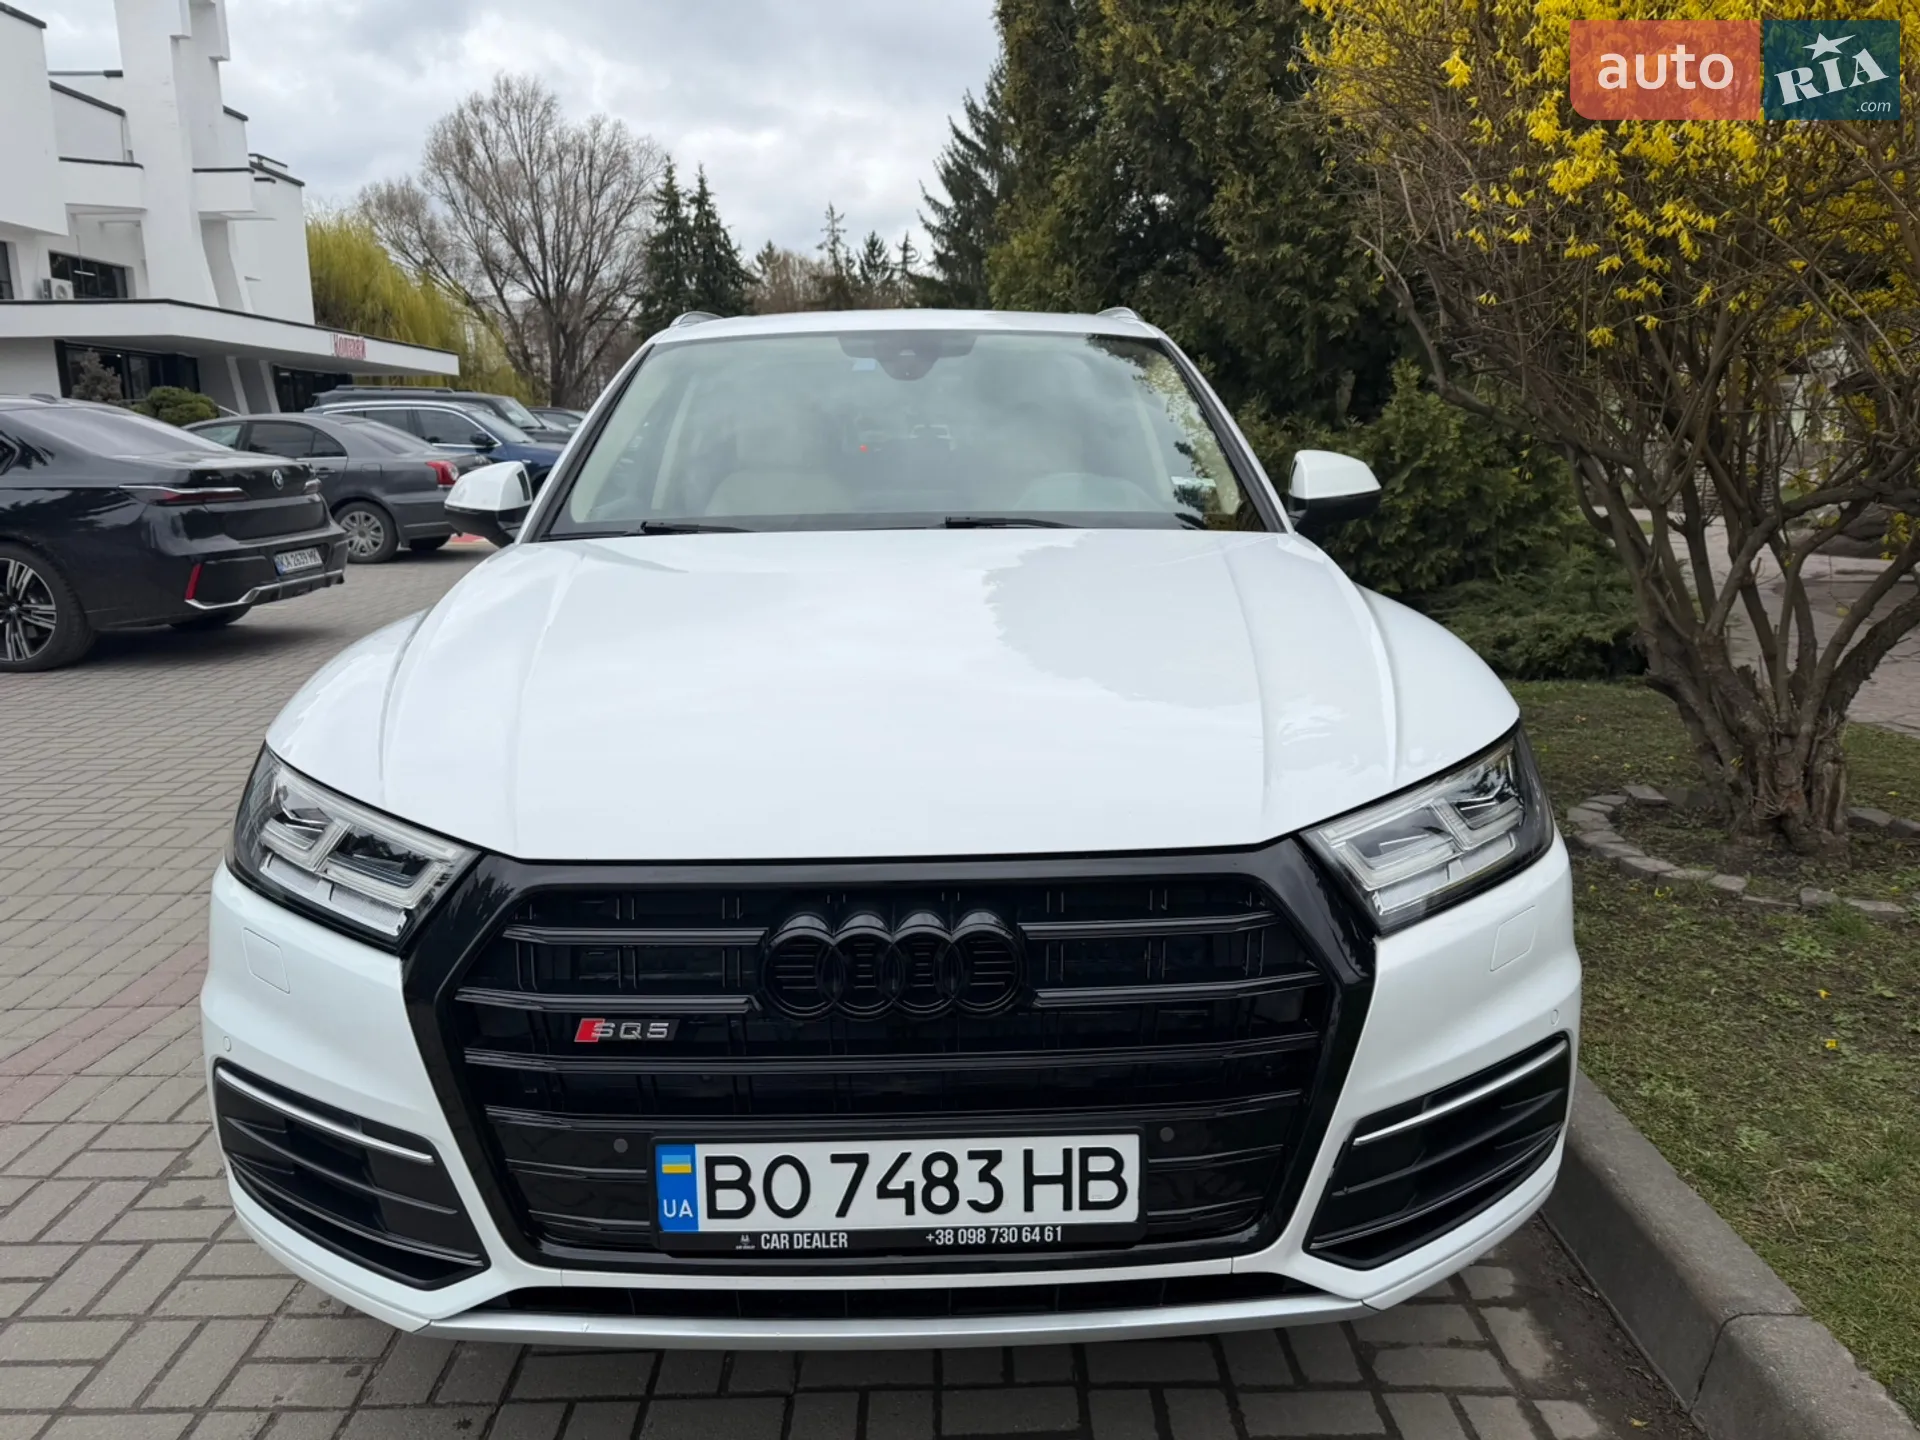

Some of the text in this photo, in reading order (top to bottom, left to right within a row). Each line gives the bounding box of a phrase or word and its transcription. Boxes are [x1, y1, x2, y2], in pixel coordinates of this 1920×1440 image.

[591, 1022, 670, 1040] SQ5
[704, 1146, 1128, 1220] BO 7483 HB
[662, 1198, 694, 1219] UA
[760, 1231, 849, 1250] CAR DEALER
[925, 1225, 1062, 1246] +38 098 730 64 61
